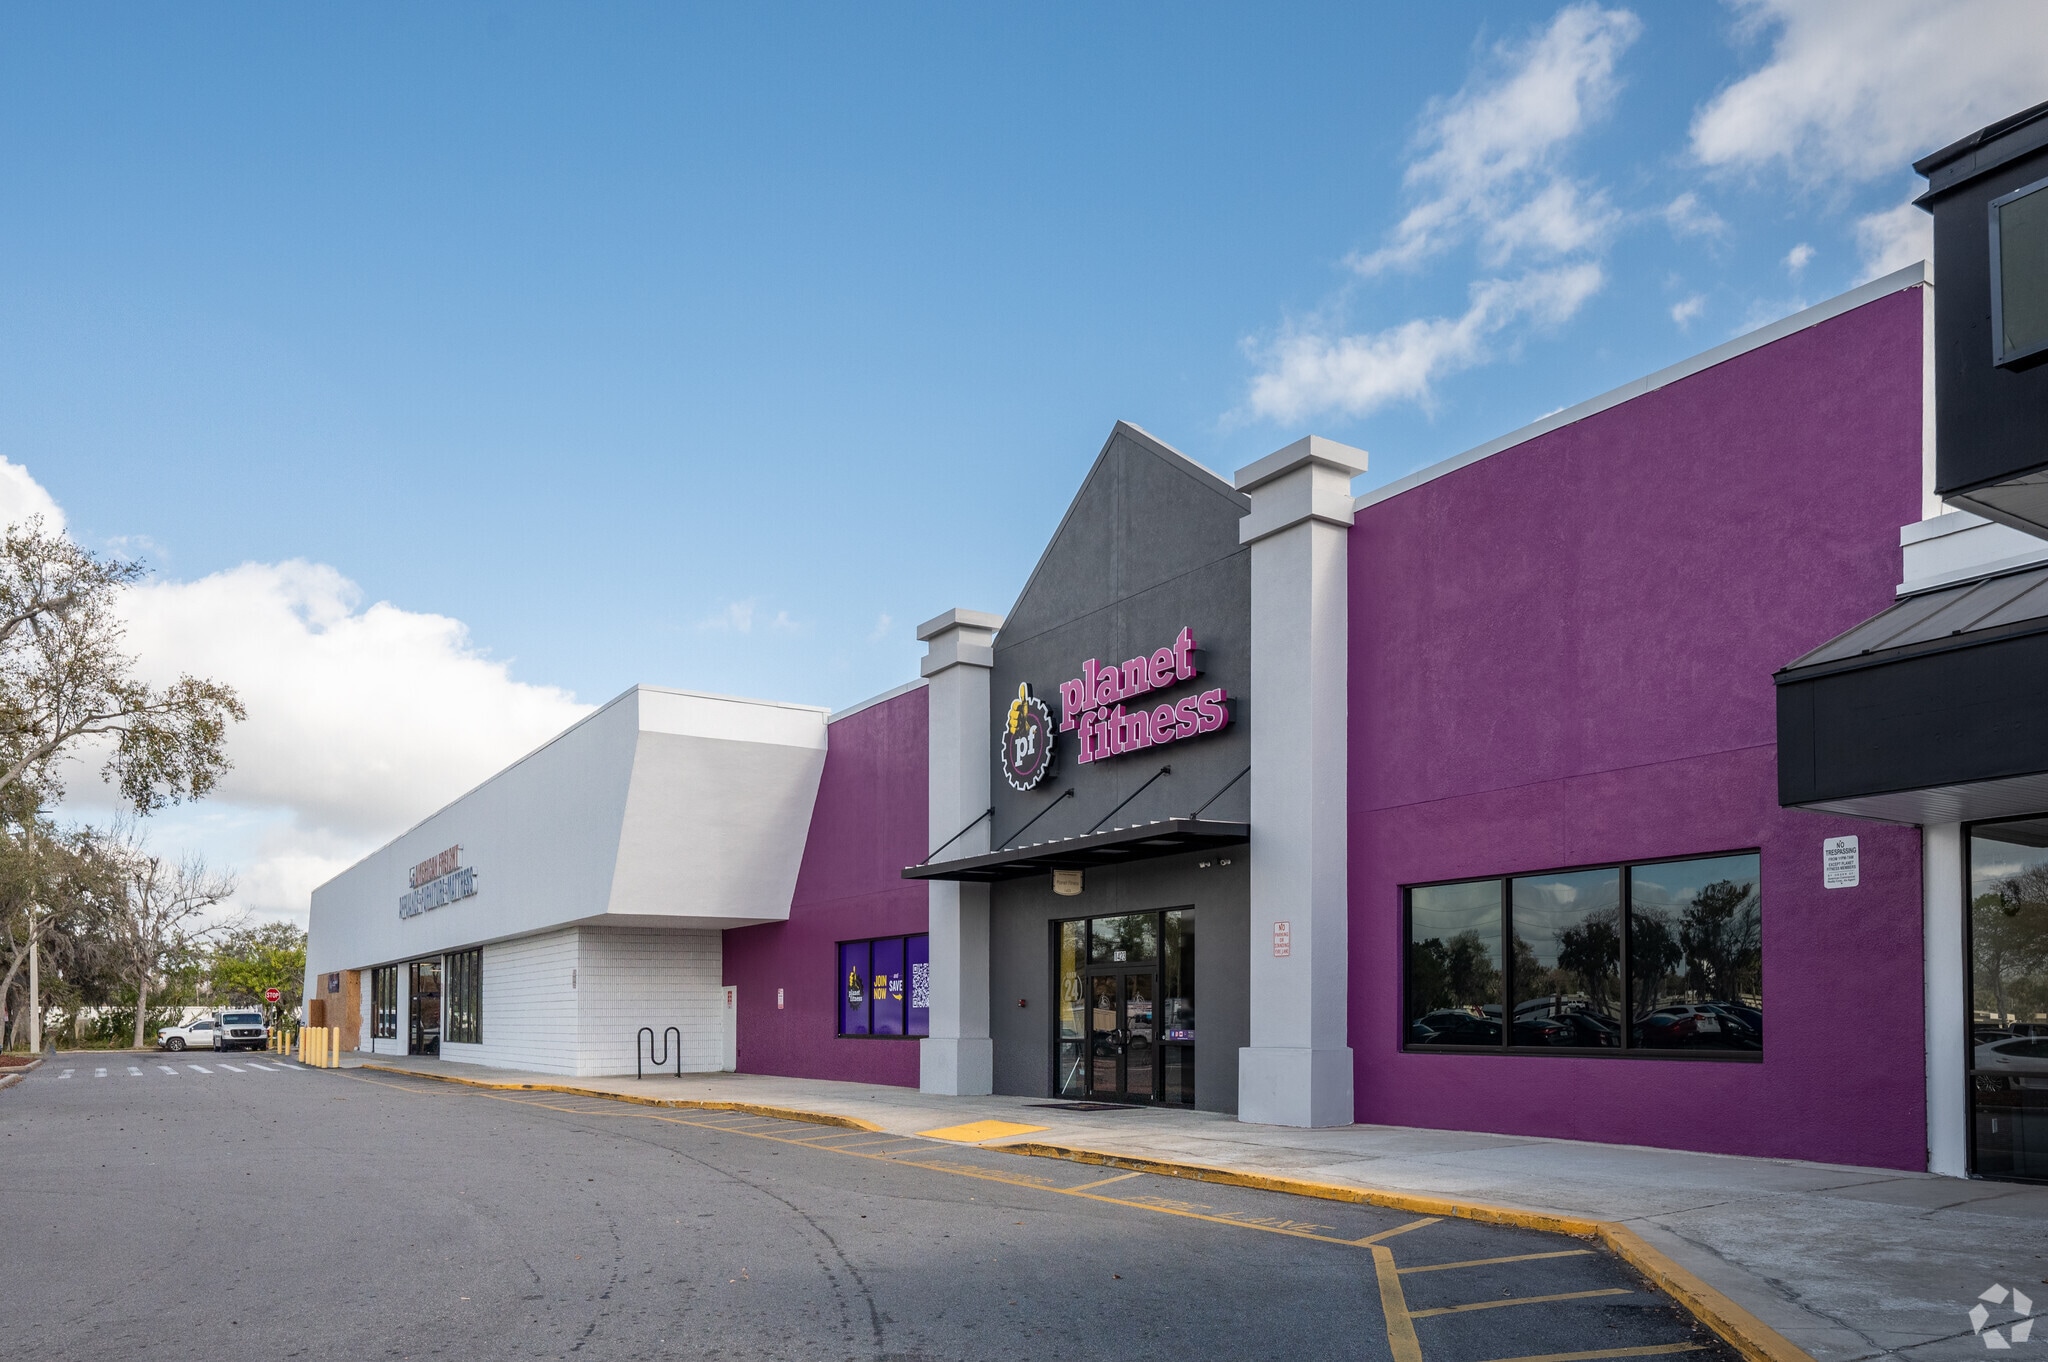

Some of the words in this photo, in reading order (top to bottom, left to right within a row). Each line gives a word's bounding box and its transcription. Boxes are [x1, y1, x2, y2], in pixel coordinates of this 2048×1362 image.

[1059, 625, 1197, 733] planet
[1077, 688, 1229, 764] fitness
[1014, 725, 1037, 767] pf
[1825, 847, 1857, 856] TRESPASSING
[1278, 923, 1286, 931] NO
[874, 975, 887, 987] JOIN
[889, 980, 903, 992] SAVE
[873, 988, 887, 1000] NOW
[1064, 979, 1079, 1001] 24
